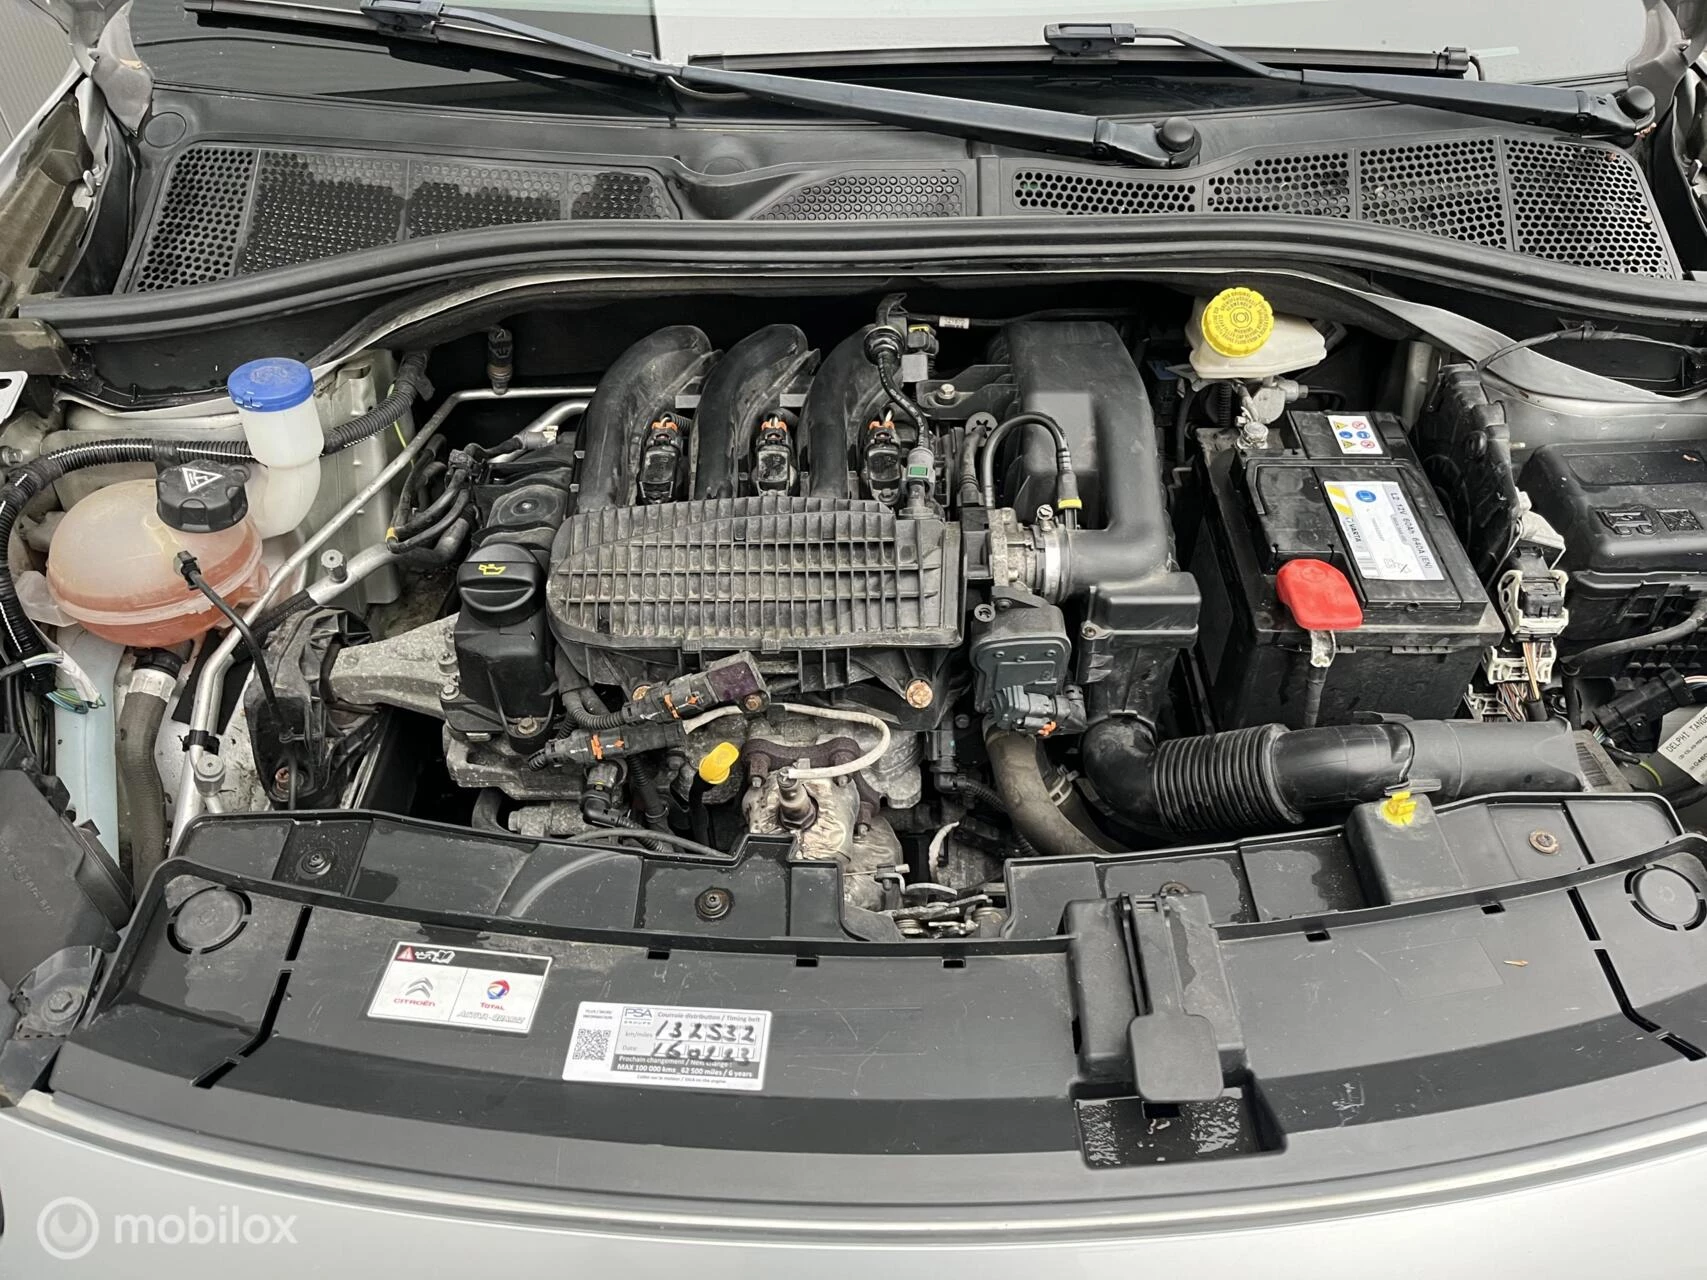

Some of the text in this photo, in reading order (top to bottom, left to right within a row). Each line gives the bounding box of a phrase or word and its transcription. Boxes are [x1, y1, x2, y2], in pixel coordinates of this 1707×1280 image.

[1349, 522, 1362, 542] VARTA
[1397, 503, 1407, 515] 12V
[1420, 554, 1433, 569] (EN)
[1665, 731, 1690, 753] DELPHI
[480, 1002, 505, 1010] TOTAL
[624, 1008, 653, 1018] PSA
[726, 1014, 747, 1022] Timing
[617, 1063, 634, 1071] MAX
